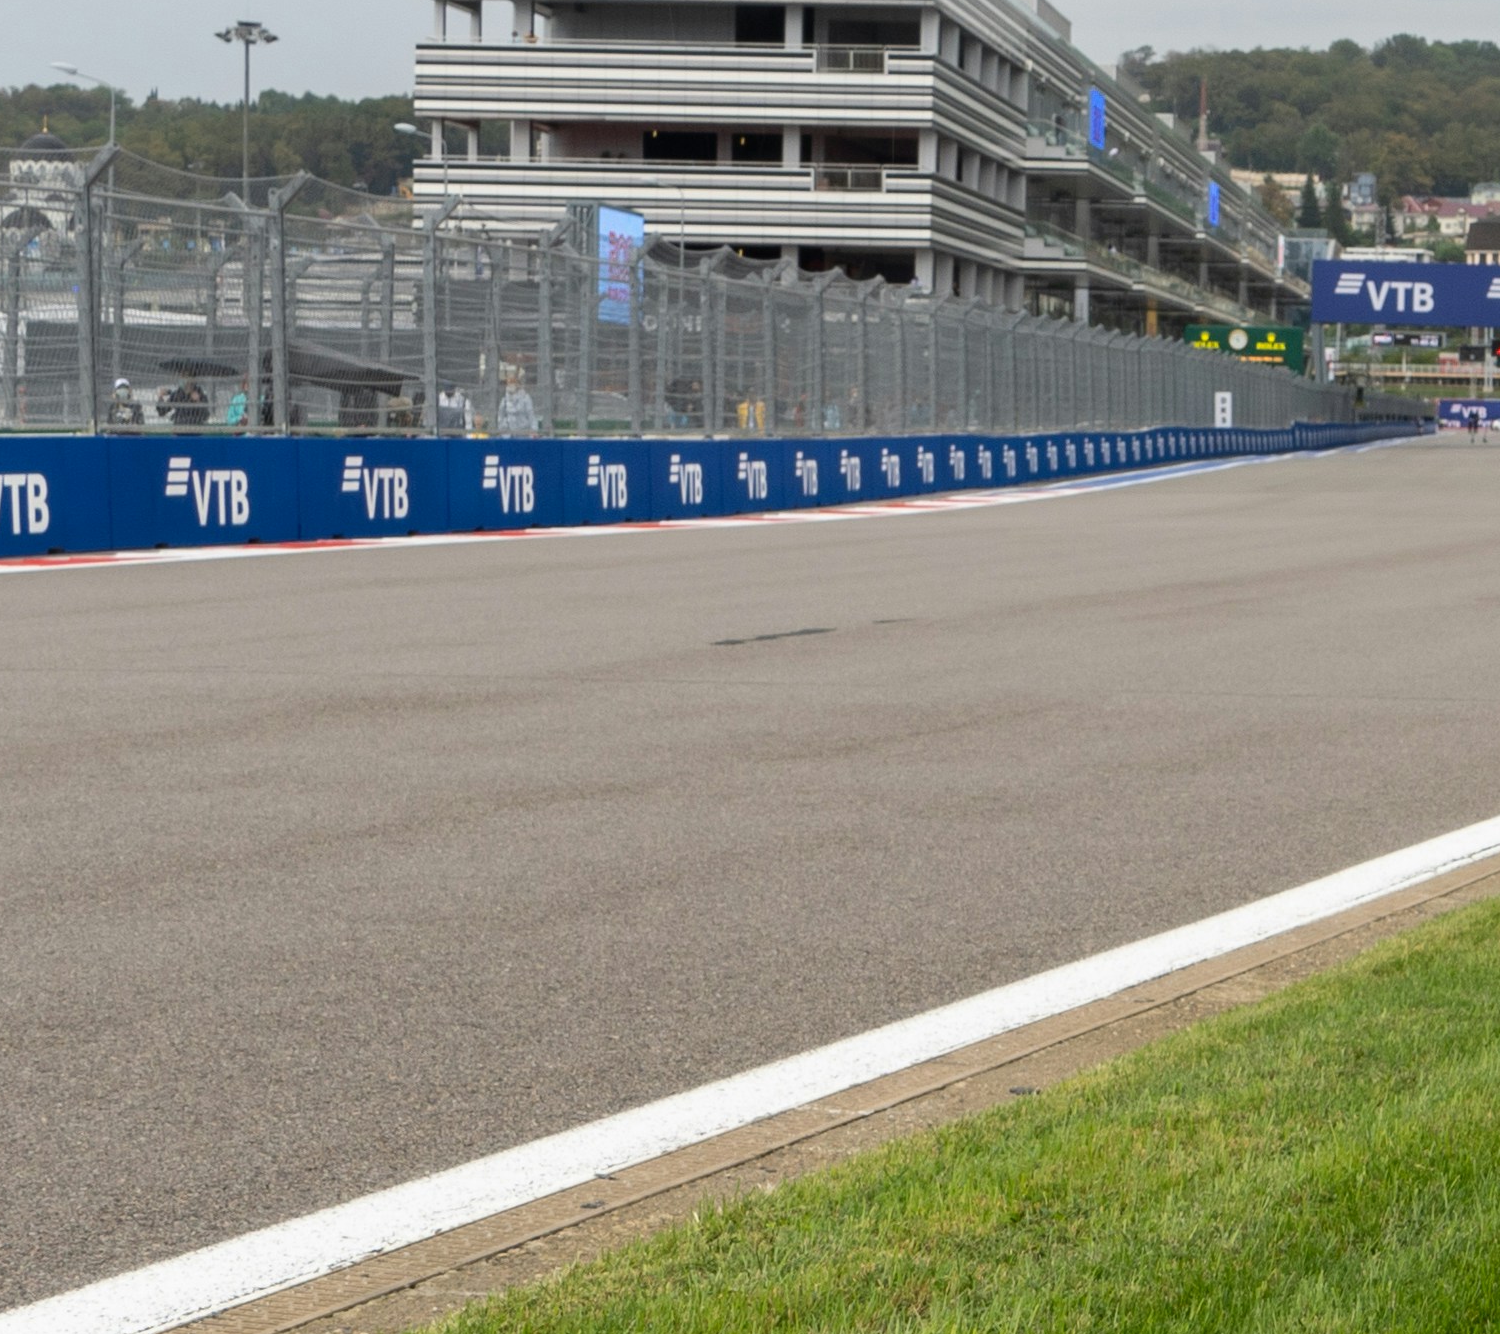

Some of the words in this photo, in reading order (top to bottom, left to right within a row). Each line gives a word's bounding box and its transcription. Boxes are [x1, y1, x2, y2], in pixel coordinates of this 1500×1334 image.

[1367, 281, 1434, 313] VTB
[192, 469, 250, 526] VTB
[363, 467, 409, 520] VTB
[499, 465, 535, 514] VTB
[600, 464, 628, 509] VTB
[679, 463, 703, 505] VTB
[747, 461, 768, 500] VTB
